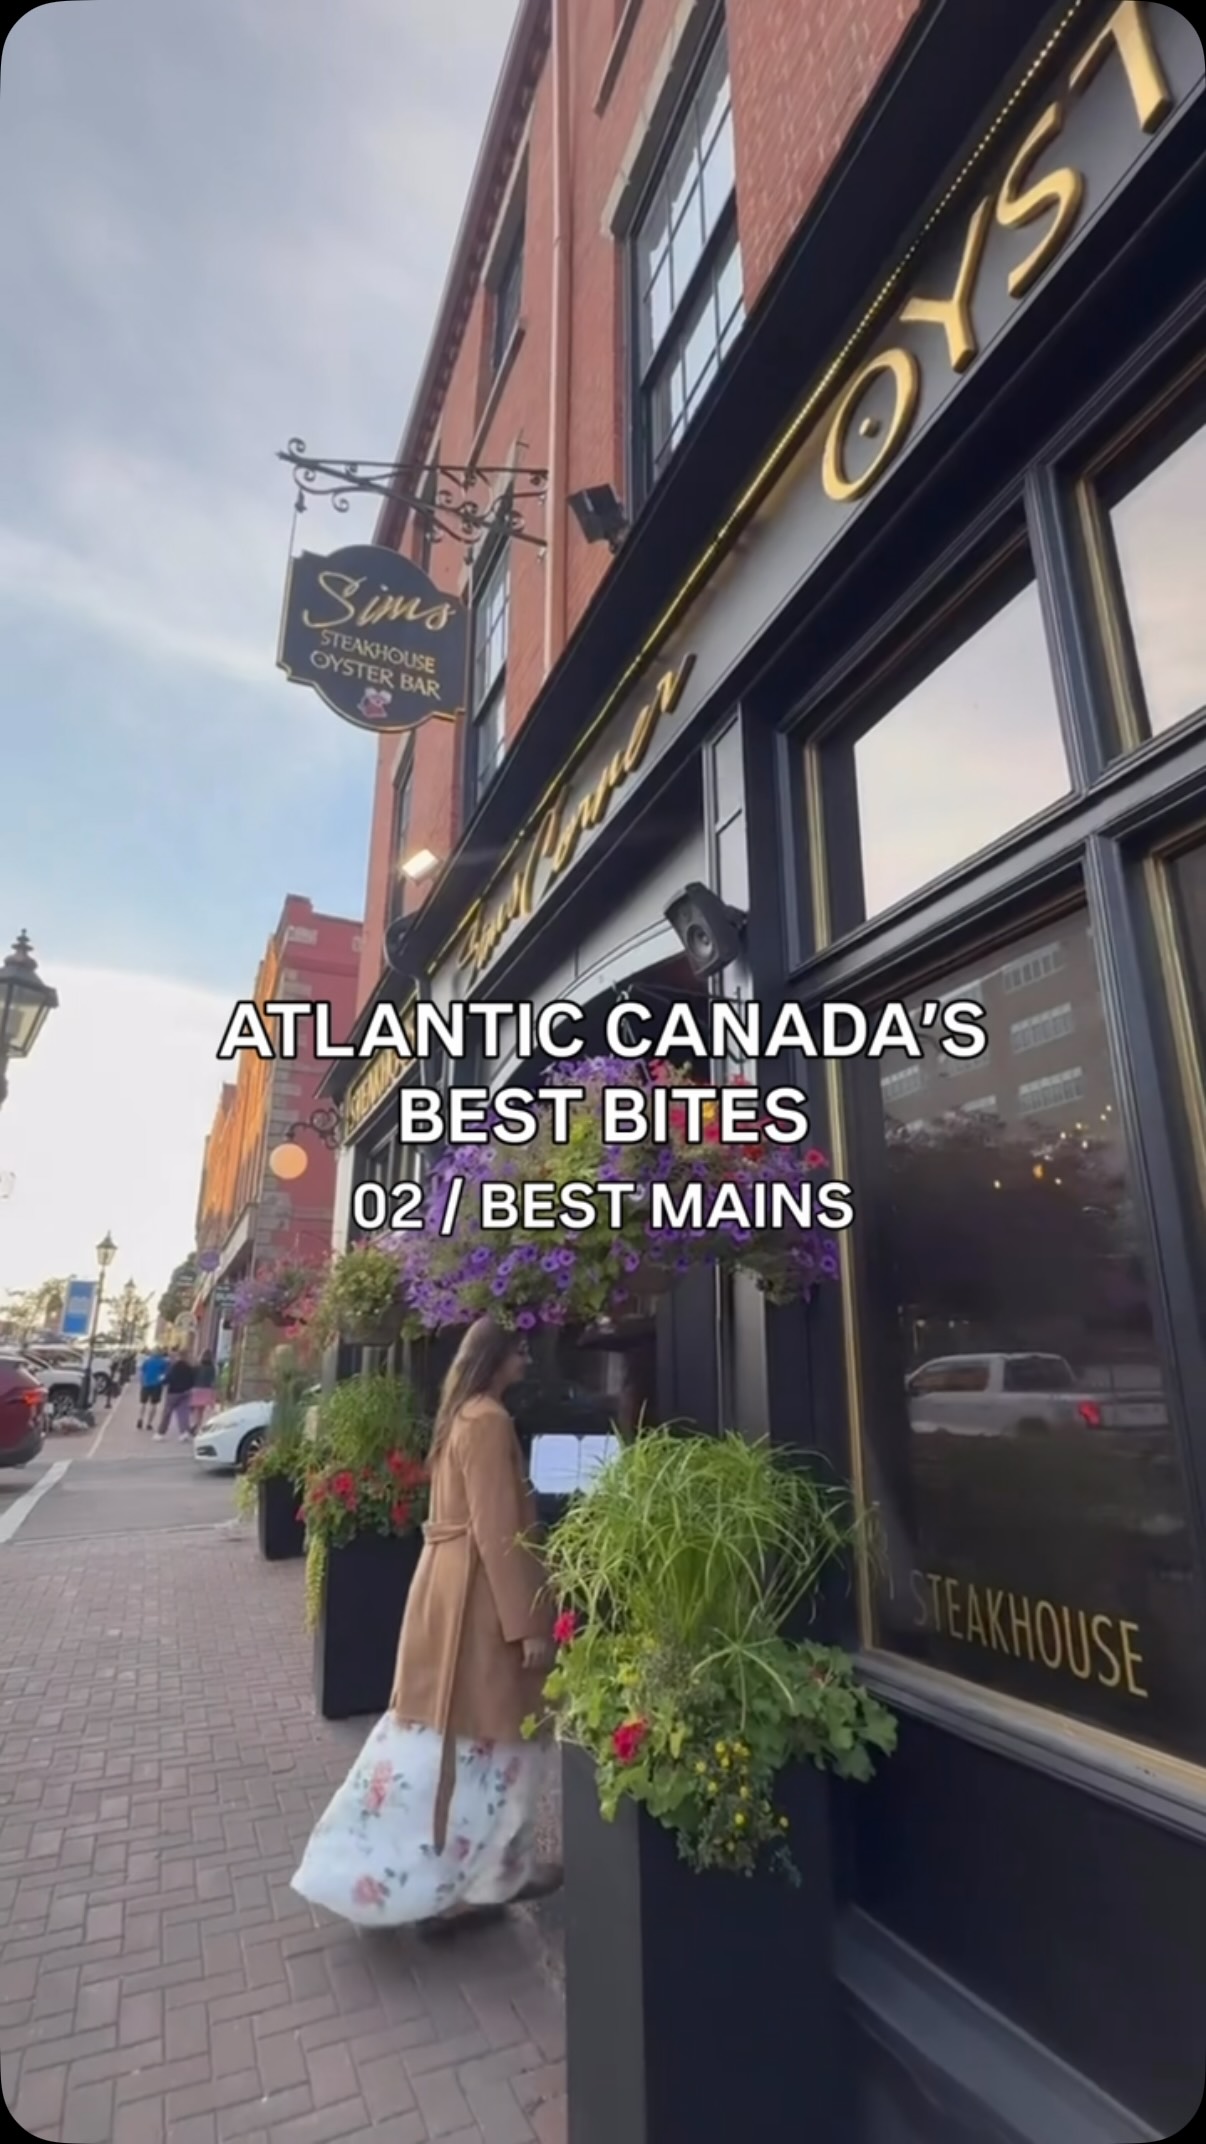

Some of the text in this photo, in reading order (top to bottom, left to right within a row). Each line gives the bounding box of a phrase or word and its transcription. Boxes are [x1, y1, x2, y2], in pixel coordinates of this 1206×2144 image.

[302, 570, 457, 631] Sims
[310, 650, 442, 701] OYSTER BAR
[320, 629, 436, 674] STEAKHOUSE
[909, 1569, 1148, 1698] STEAKHOUSE
